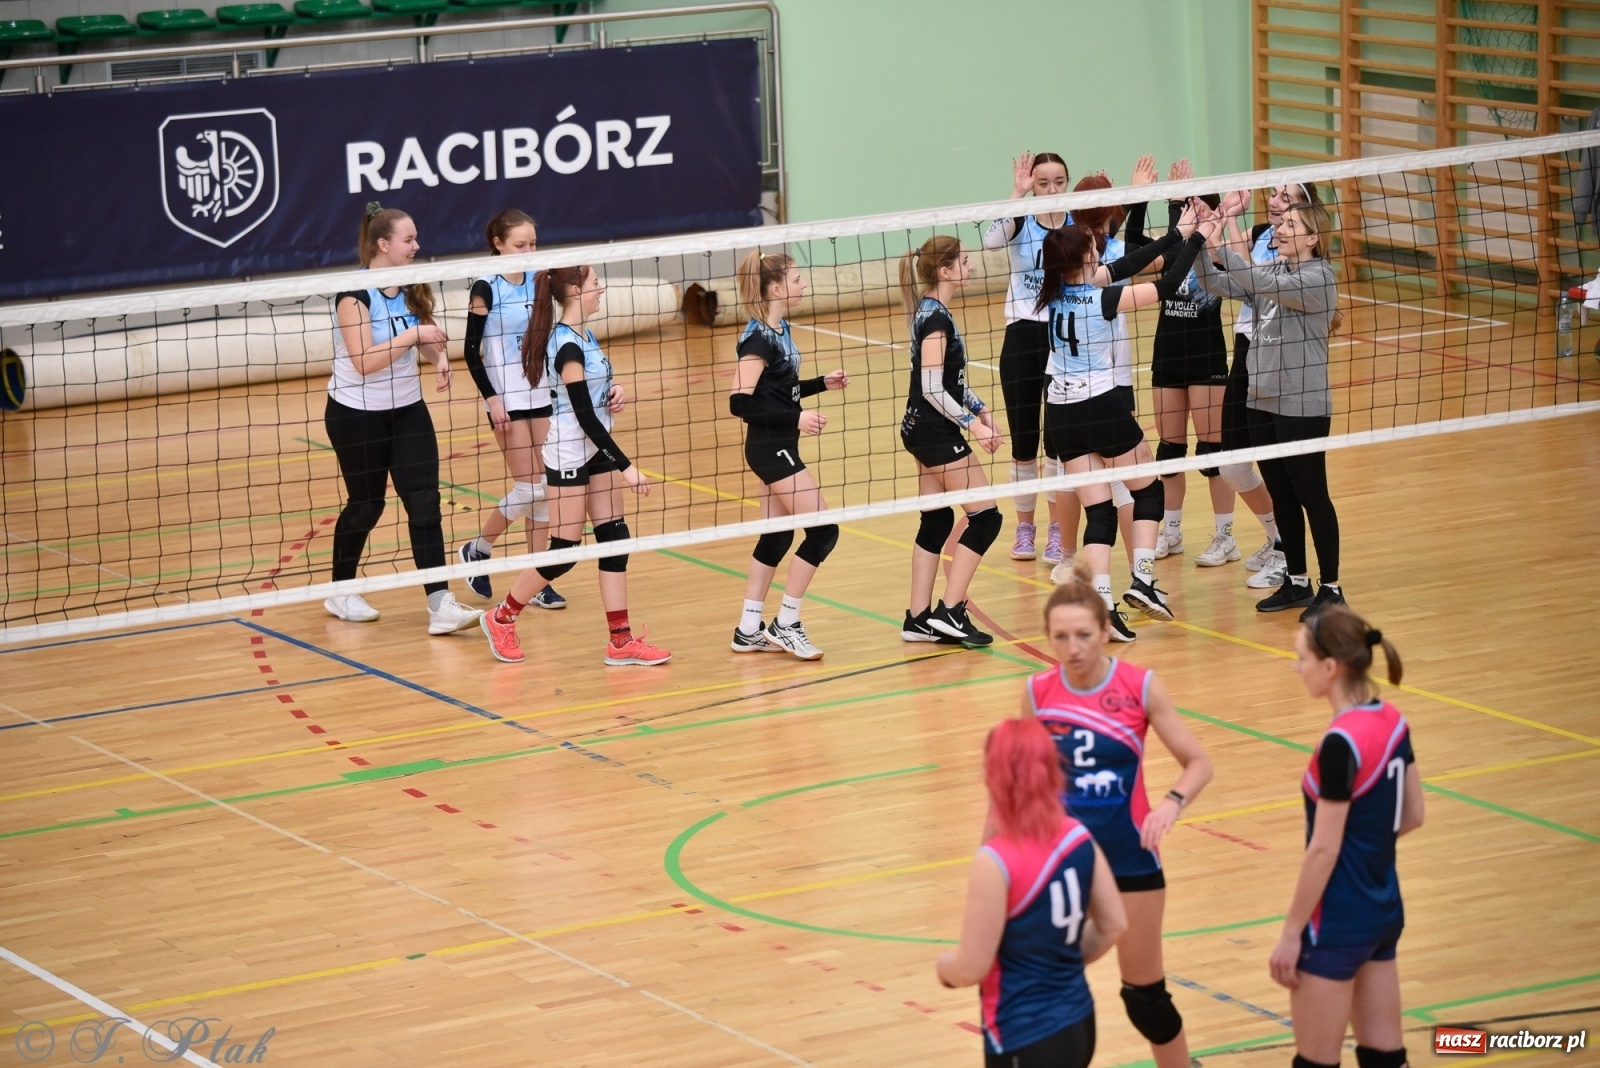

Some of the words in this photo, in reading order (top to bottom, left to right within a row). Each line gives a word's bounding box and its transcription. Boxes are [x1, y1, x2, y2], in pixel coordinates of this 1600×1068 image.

[346, 104, 674, 194] RACIBÓRZ
[1174, 301, 1199, 311] VOLLEY
[1048, 307, 1080, 357] 14
[776, 449, 795, 467] 7
[1073, 729, 1096, 767] 2
[1386, 755, 1406, 833] 7
[1049, 866, 1085, 946] 4
